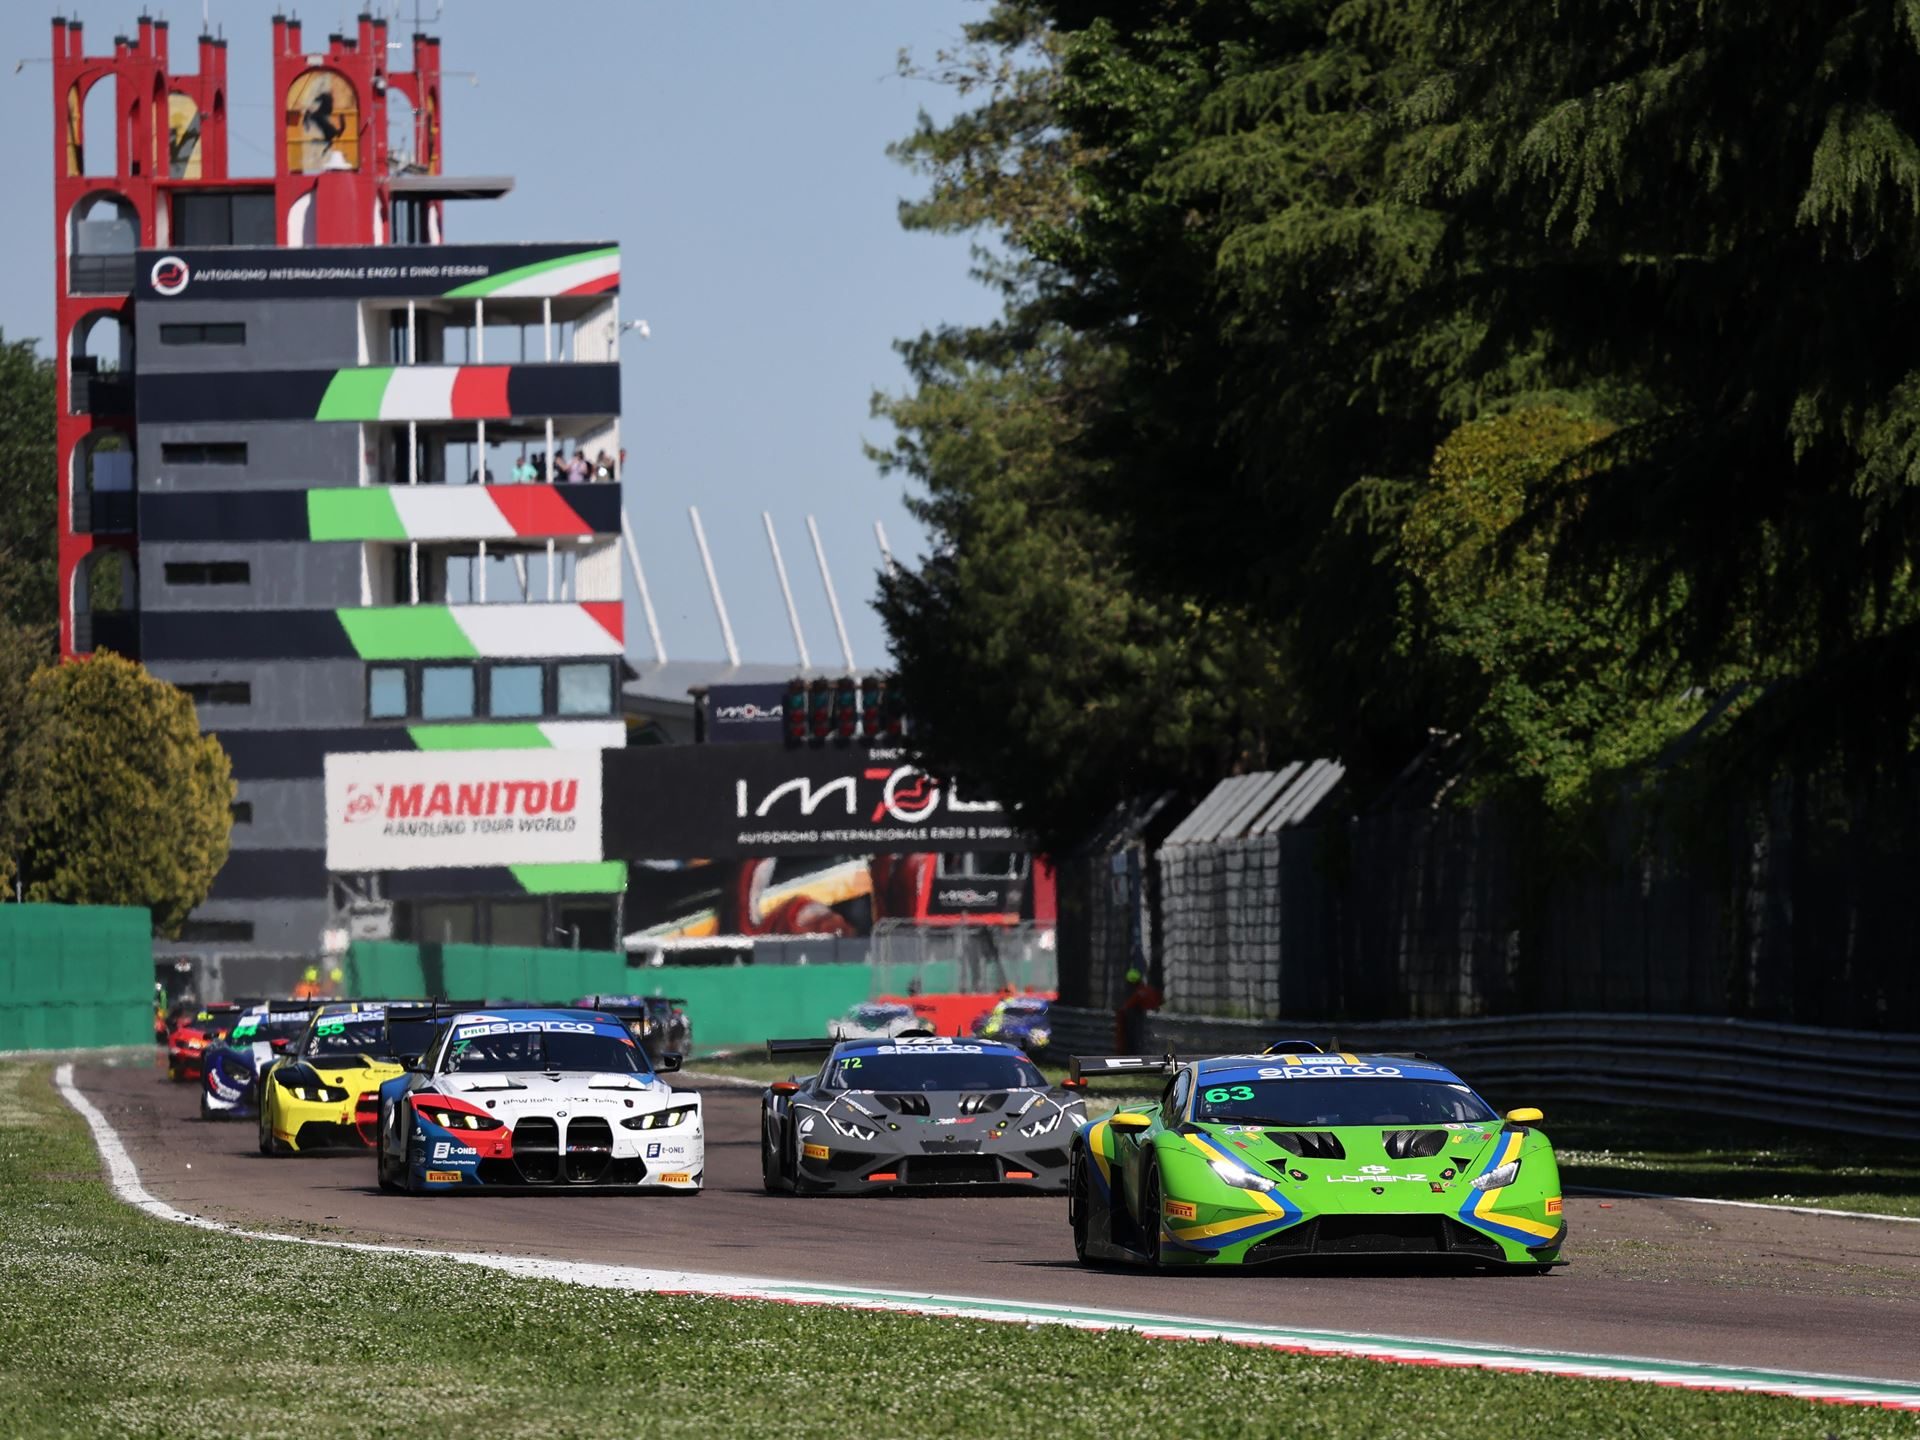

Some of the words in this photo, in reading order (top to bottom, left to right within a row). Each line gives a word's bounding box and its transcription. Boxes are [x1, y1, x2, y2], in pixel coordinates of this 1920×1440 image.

[193, 269, 267, 281] AUTODROMO
[268, 267, 365, 280] INTERNAZIONALE
[367, 266, 398, 279] ENZO
[400, 266, 407, 278] E
[409, 265, 440, 278] DINO
[441, 265, 489, 277] FERRARI
[386, 779, 579, 819] MANITOU
[383, 820, 466, 837] HANDLING
[472, 818, 514, 834] YOUR
[519, 817, 577, 833] WORLD
[737, 830, 818, 844] AUTODROMO
[820, 828, 928, 842] INTERNAZIONALE
[930, 827, 965, 840] ENZO
[967, 827, 976, 839] E
[317, 1024, 346, 1037] 55
[463, 1027, 486, 1036] PRO
[490, 1021, 596, 1035] sparco
[453, 1040, 471, 1055] 7
[877, 1045, 984, 1055] sparco
[841, 1058, 863, 1070] 72
[1257, 1066, 1404, 1079] sparco
[1205, 1086, 1255, 1103] 63
[450, 1147, 477, 1155] E-ONES
[661, 1173, 689, 1182] PIRELLI
[1326, 1174, 1428, 1183] LORENZ
[1166, 1202, 1193, 1217] PIRELLI
